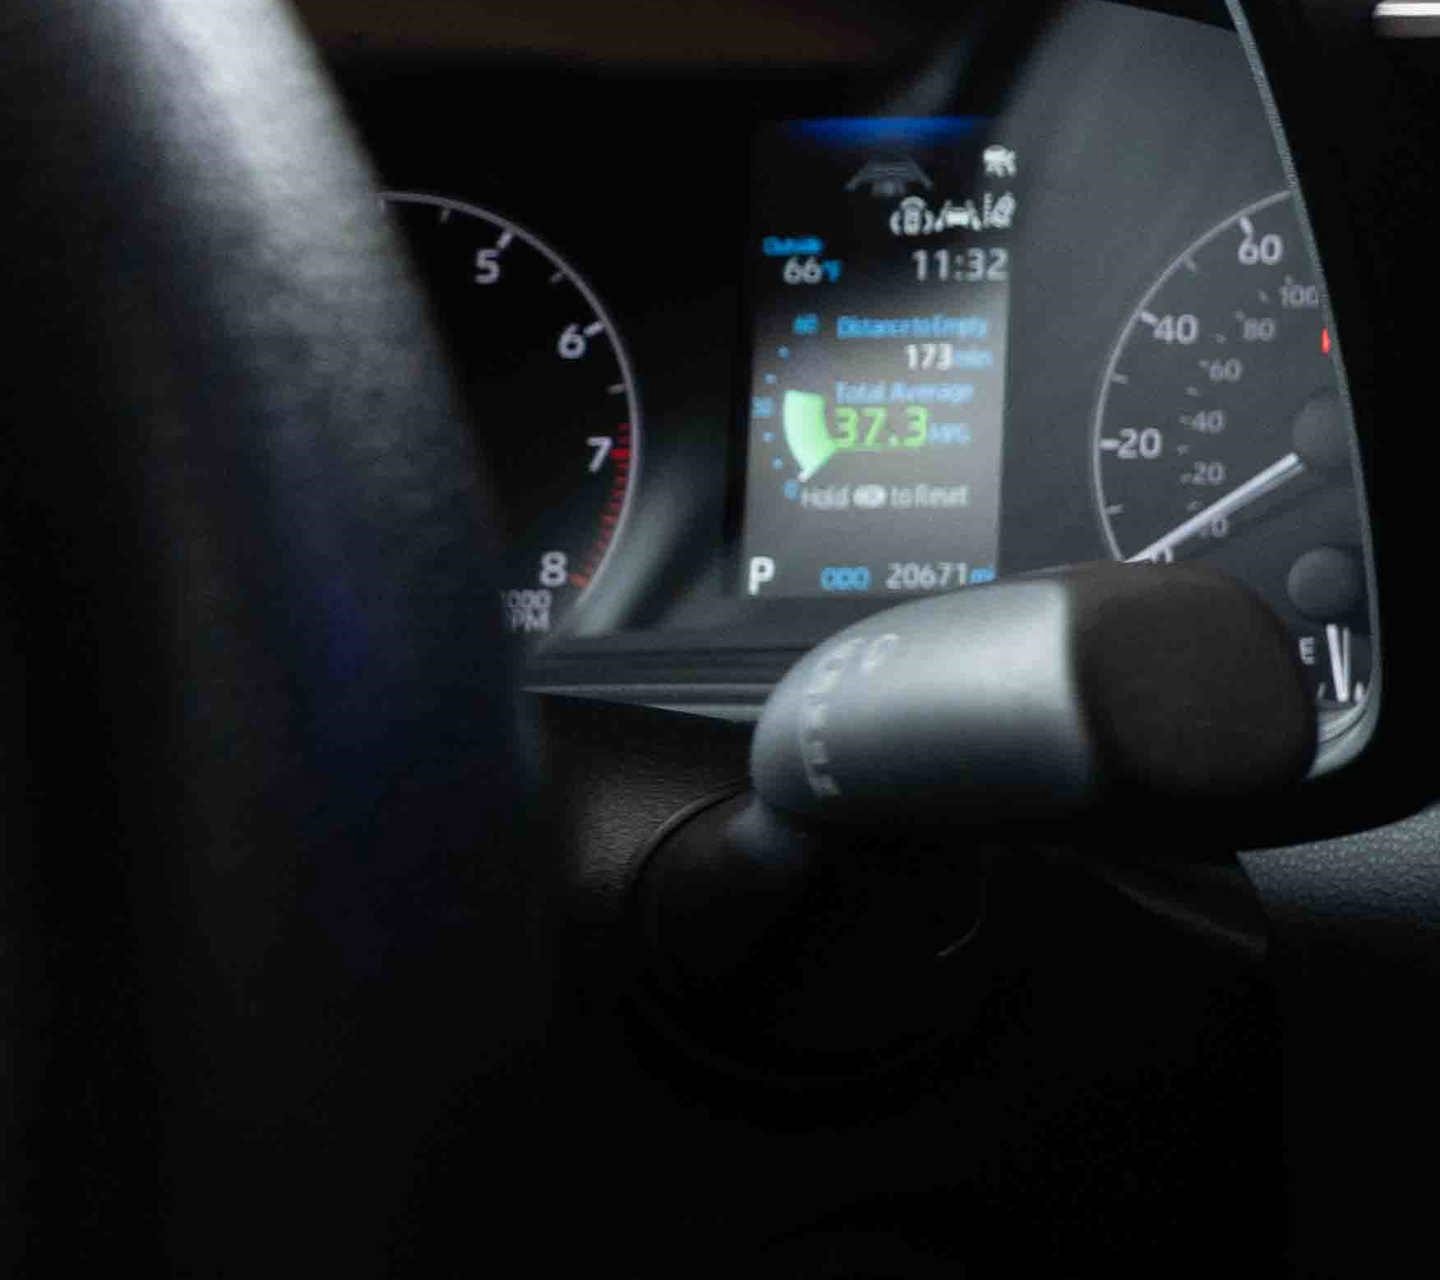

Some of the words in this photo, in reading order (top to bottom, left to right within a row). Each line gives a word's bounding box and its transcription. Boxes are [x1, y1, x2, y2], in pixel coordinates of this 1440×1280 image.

[911, 247, 1009, 283] 11:32
[1237, 233, 1283, 266] 60
[474, 248, 501, 284] 5
[1279, 282, 1320, 310] 100
[556, 324, 587, 360] 6
[1152, 314, 1199, 345] 40
[904, 342, 954, 371] 173
[1208, 358, 1243, 382] 60
[833, 405, 930, 448] 37.3
[1191, 409, 1225, 433] 40
[584, 435, 615, 473] 7
[1117, 427, 1162, 460] 20
[1191, 461, 1225, 486] 20
[800, 484, 850, 509] Hold
[539, 550, 568, 588] 8
[748, 556, 776, 596] P
[885, 562, 968, 591] 20671
[1299, 636, 1316, 666] E
